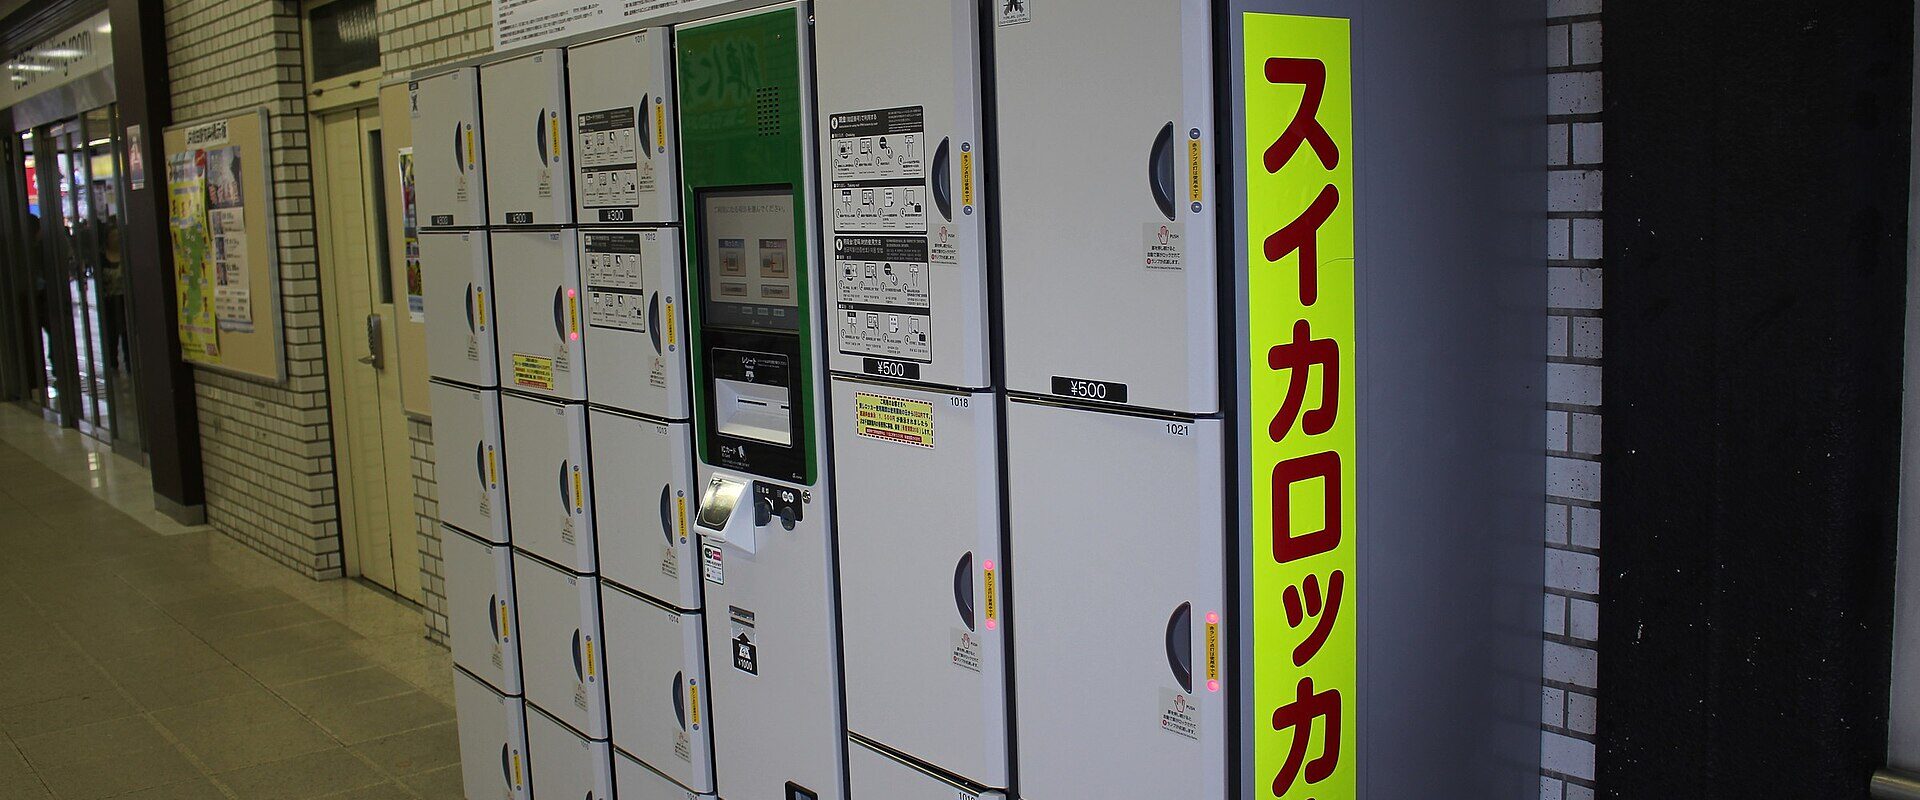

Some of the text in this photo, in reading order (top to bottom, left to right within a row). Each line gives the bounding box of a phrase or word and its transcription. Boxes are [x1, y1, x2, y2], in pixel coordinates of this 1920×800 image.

[645, 233, 656, 241] 1012
[877, 361, 904, 377] ¥500
[1070, 380, 1106, 399] ¥500
[950, 397, 969, 408] 1018
[656, 426, 667, 435] 1013
[1166, 423, 1189, 436] 1021
[1264, 58, 1343, 800] スイカロッカ
[668, 614, 680, 624] 1014
[737, 657, 753, 671] ¥1000
